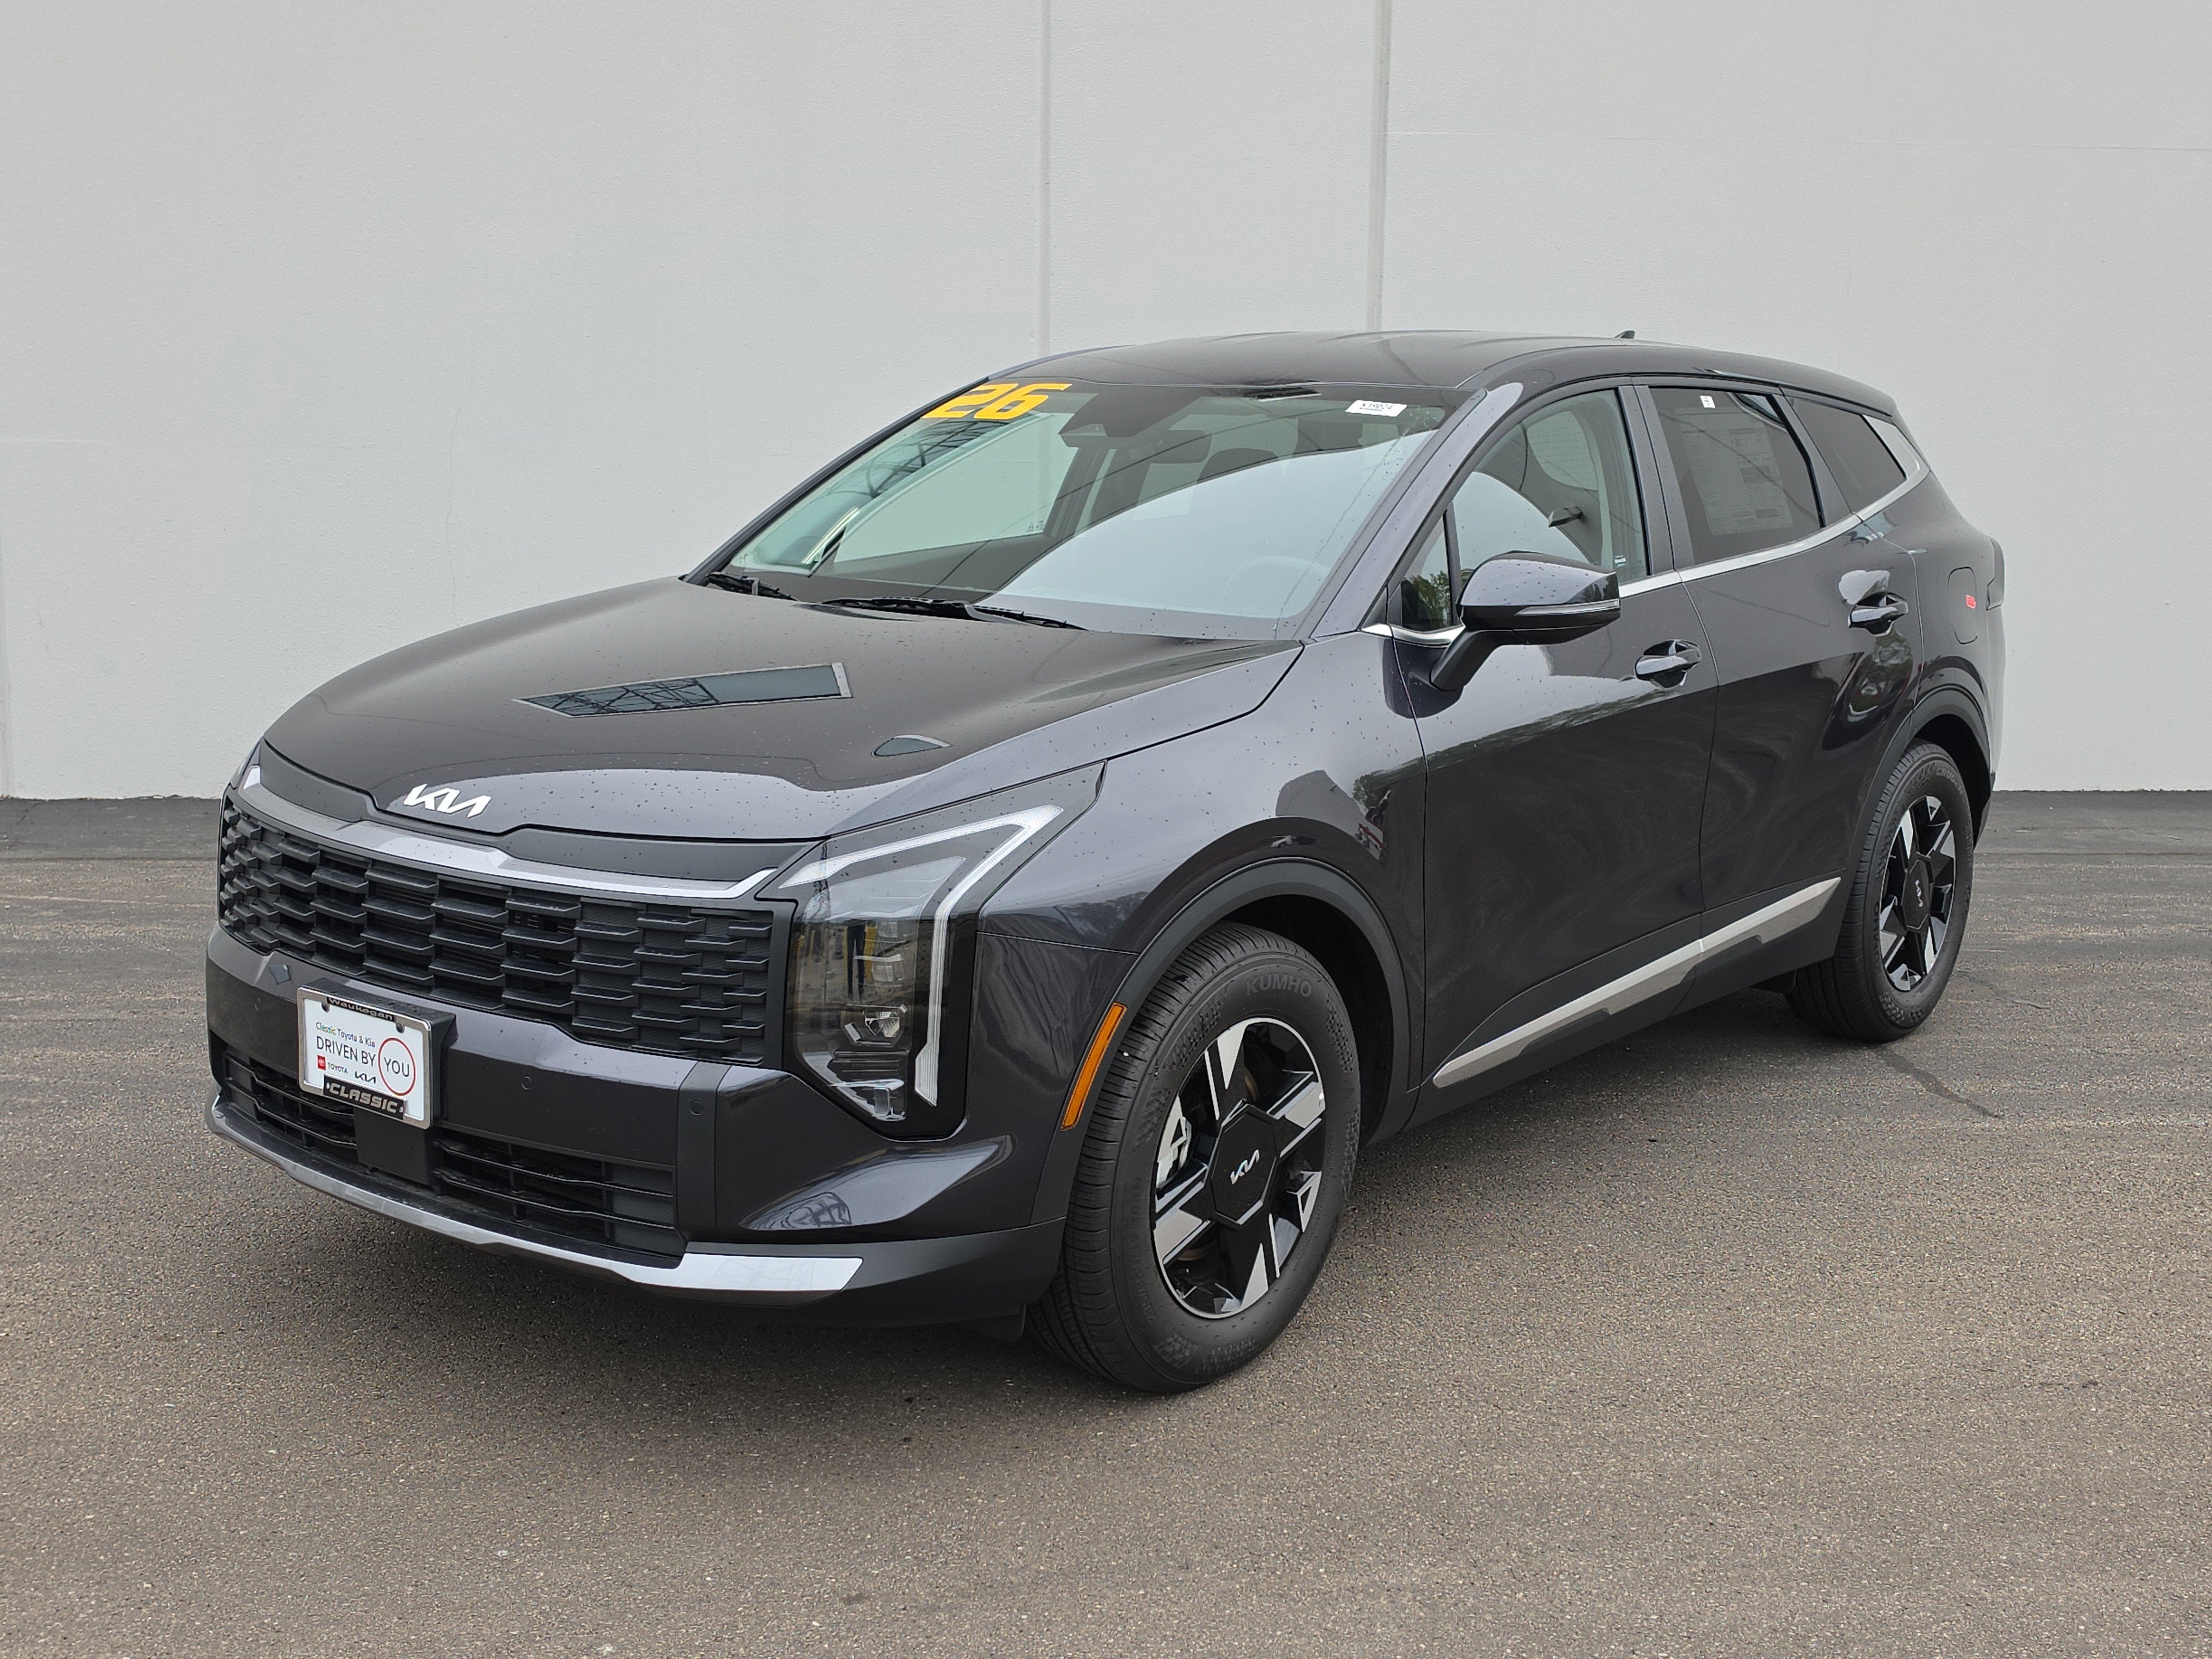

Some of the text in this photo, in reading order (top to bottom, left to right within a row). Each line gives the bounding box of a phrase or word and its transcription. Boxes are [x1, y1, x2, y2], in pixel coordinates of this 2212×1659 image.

[920, 382, 1073, 420] 26
[403, 783, 492, 818] KIA
[1246, 973, 1312, 998] KUMHO
[328, 998, 393, 1021] Waukegan
[316, 1022, 375, 1047] Classic Toyota & Kia
[317, 1036, 410, 1077] DRIVEN BY YOU
[327, 1062, 348, 1075] TOYOTA
[355, 1071, 376, 1084] KIA
[329, 1083, 398, 1113] CLASSIC
[1230, 1148, 1260, 1185] KIA
